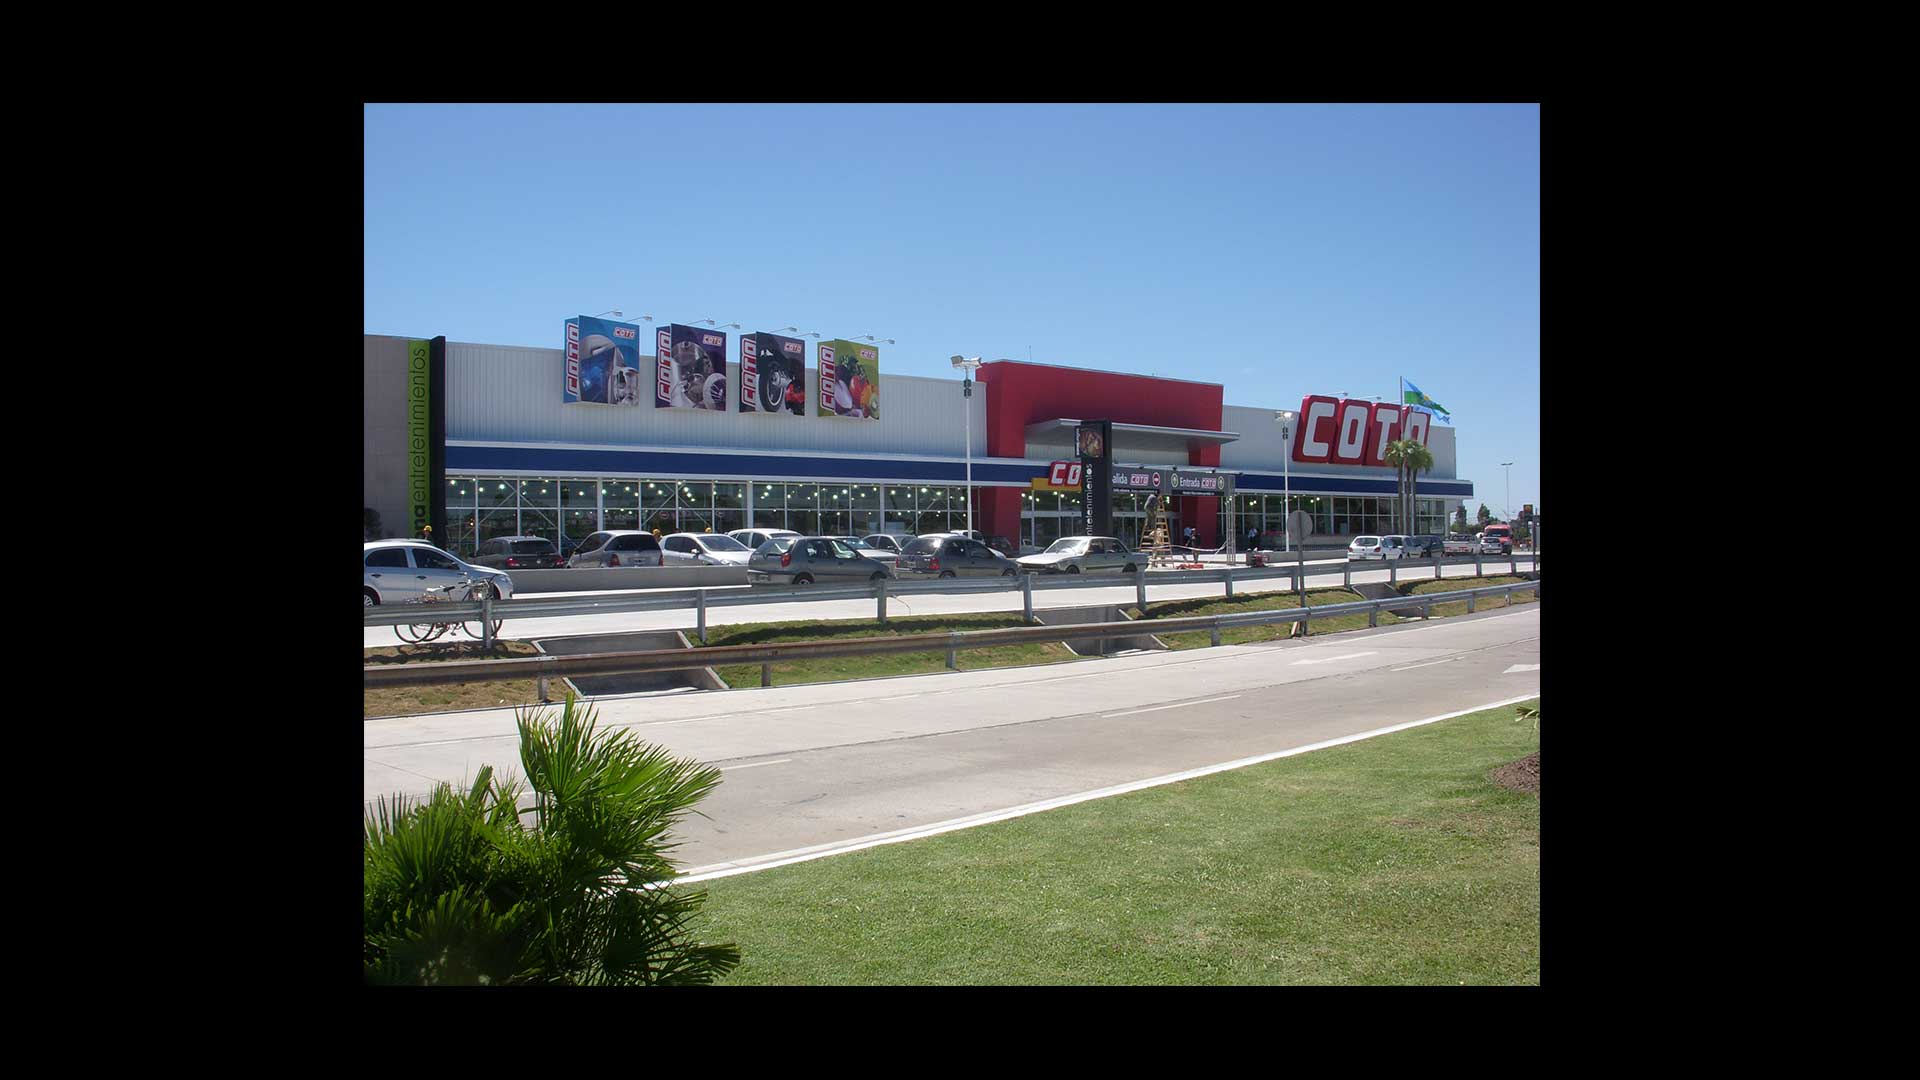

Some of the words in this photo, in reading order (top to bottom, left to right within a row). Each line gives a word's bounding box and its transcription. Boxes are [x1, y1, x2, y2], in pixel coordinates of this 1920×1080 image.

[567, 324, 579, 394] COTO
[615, 328, 635, 338] COTO
[659, 332, 671, 401] COTO
[743, 339, 757, 407] COTO
[821, 346, 835, 411] COTO
[1302, 401, 1429, 461] COTO
[1130, 474, 1149, 485] COTO
[1180, 476, 1201, 488] Entrada
[1201, 478, 1217, 488] COTO
